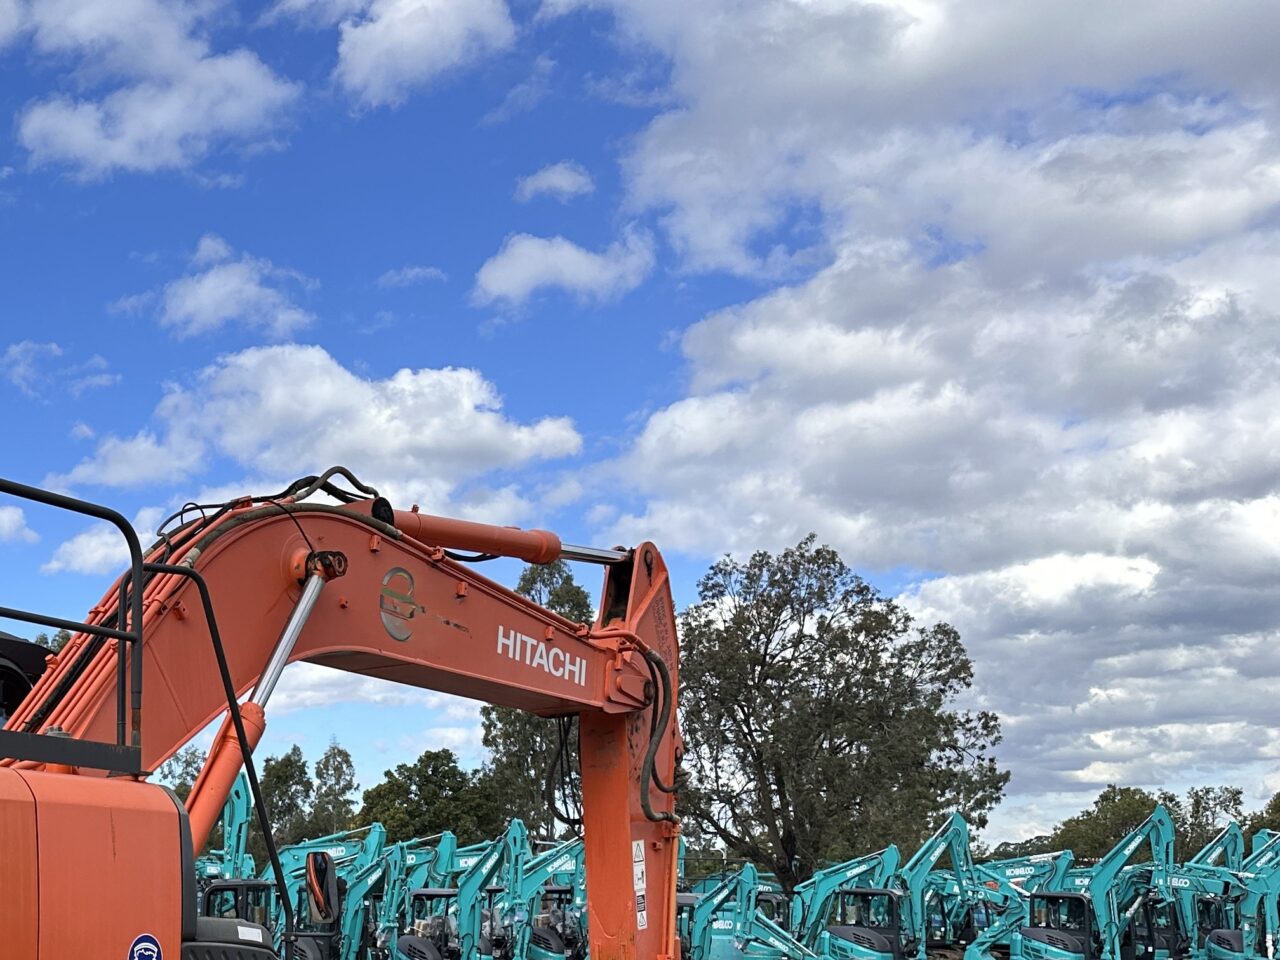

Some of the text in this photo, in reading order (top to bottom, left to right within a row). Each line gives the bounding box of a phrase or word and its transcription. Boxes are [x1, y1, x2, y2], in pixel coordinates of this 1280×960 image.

[497, 624, 587, 687] HITACHI
[546, 853, 570, 873] KOBELCO
[1005, 866, 1035, 877] KOBELCO
